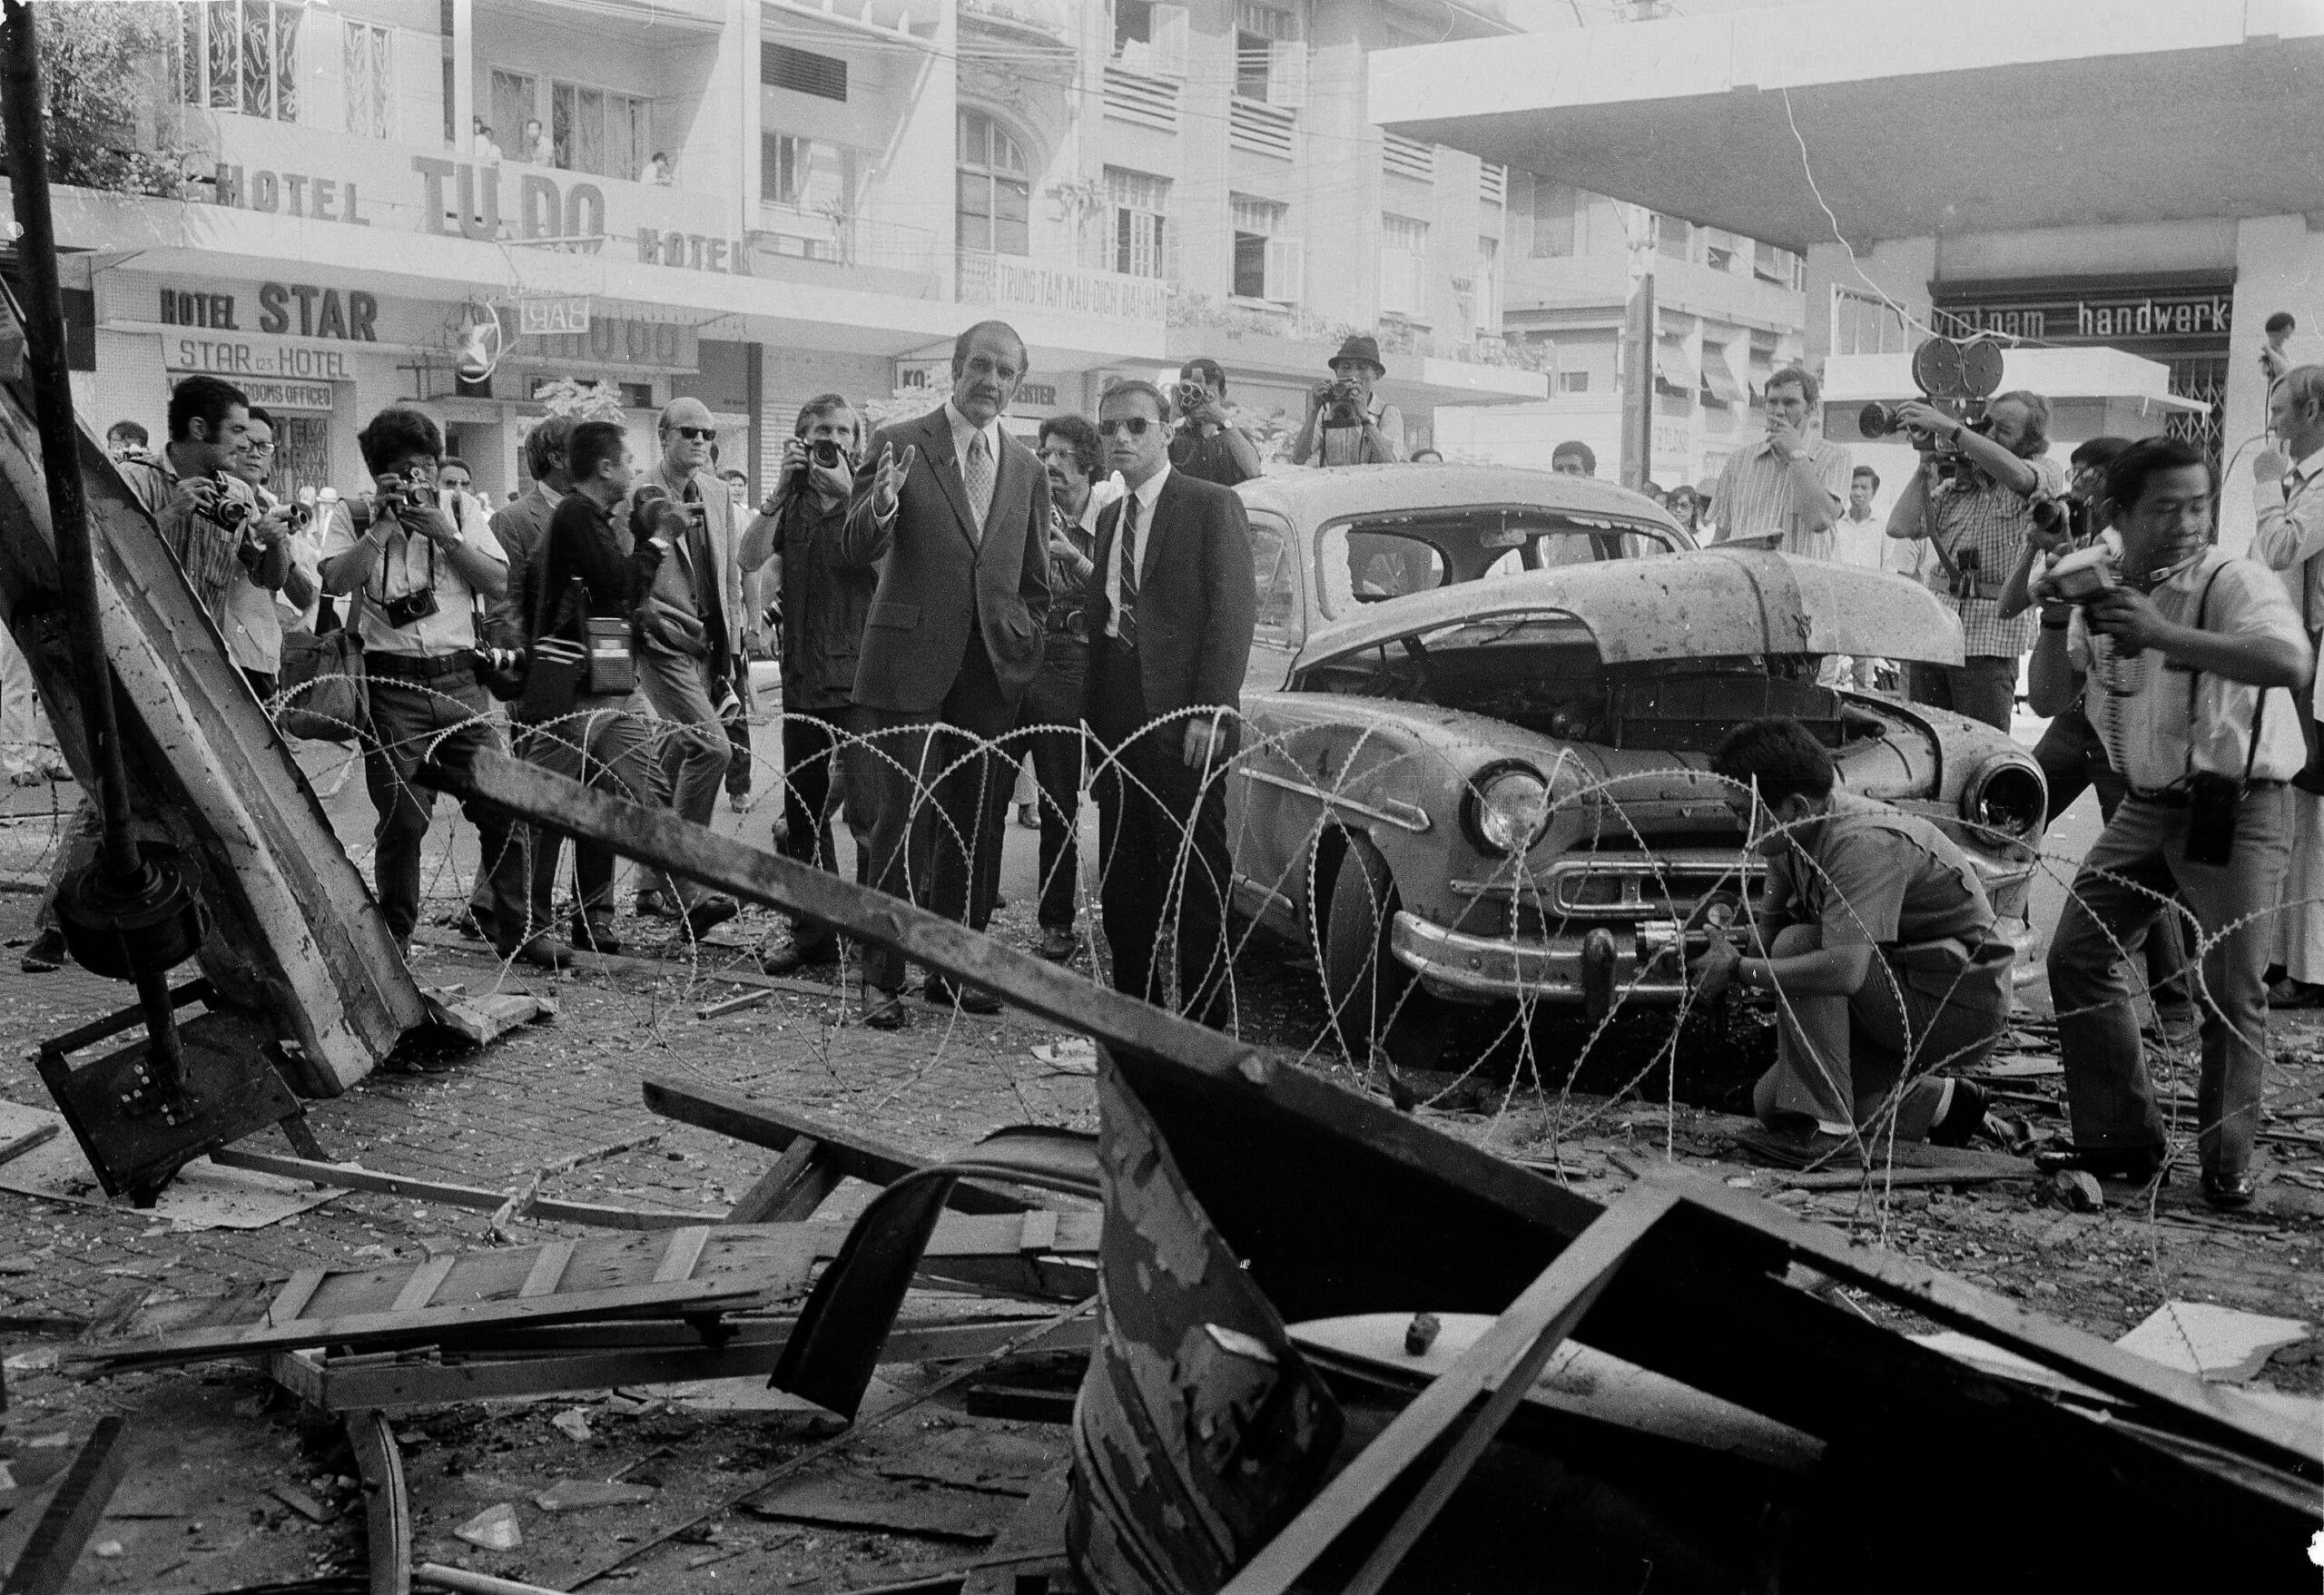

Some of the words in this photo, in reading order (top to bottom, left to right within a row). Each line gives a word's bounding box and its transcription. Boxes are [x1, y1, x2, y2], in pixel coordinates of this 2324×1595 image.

[215, 162, 370, 227] HOTEL
[521, 173, 606, 255] DO
[637, 227, 753, 277] HOTEL
[160, 289, 240, 330] HOTEL
[259, 281, 378, 342] STAR
[2078, 295, 2229, 336] handwerk
[180, 340, 252, 372] STAR
[279, 348, 350, 379] HOTEL
[243, 382, 284, 404] ROOMS
